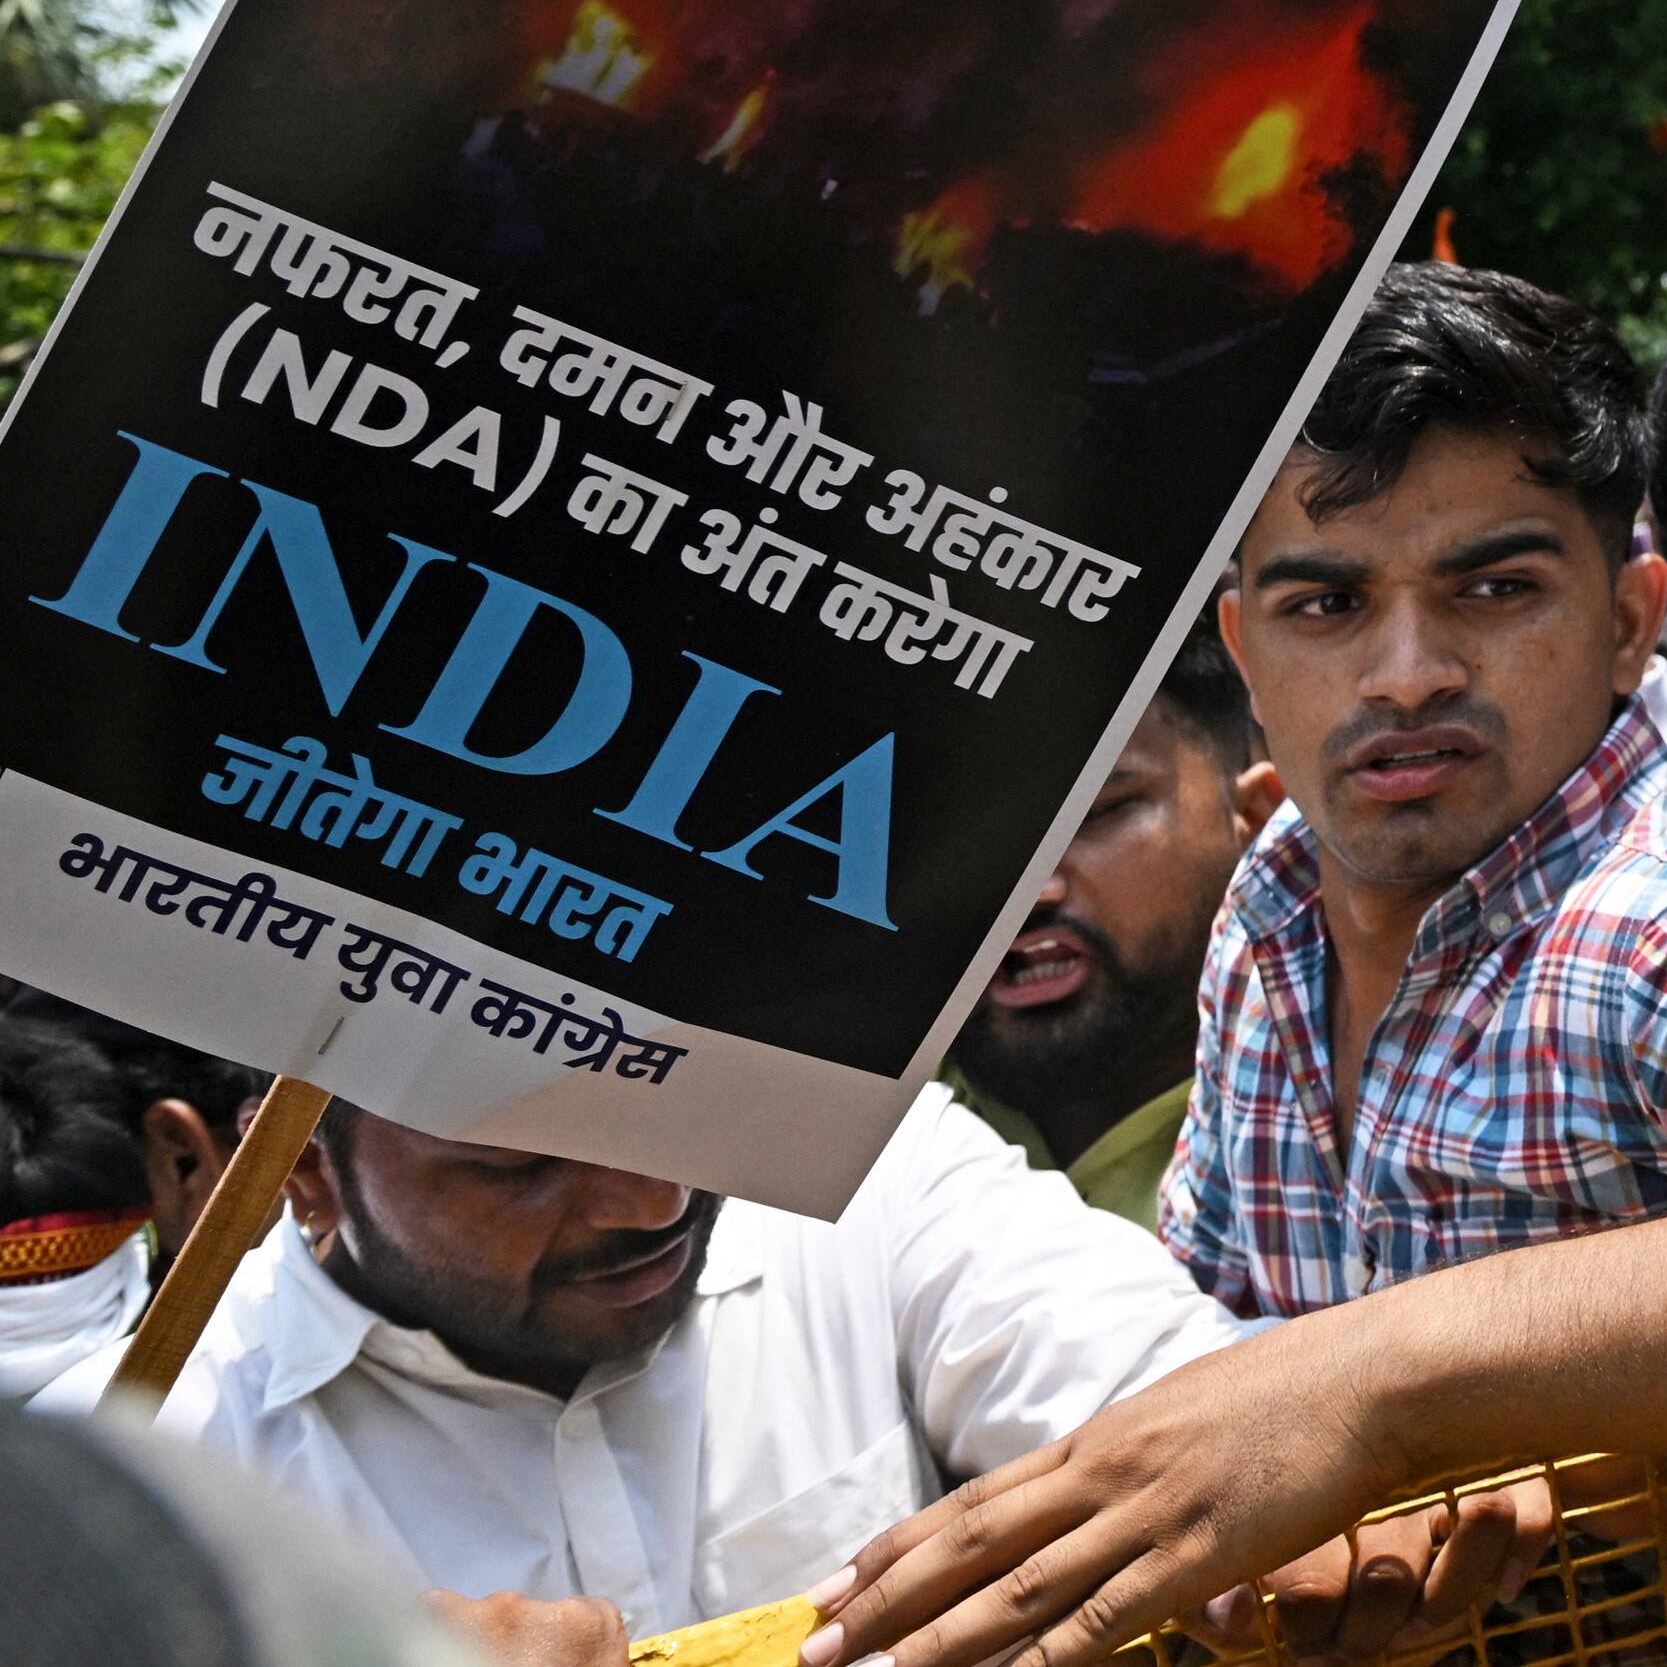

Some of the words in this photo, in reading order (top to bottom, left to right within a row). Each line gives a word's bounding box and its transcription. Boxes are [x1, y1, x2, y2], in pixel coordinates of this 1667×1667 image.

[193, 181, 480, 367] नफरत,
[498, 305, 715, 445] दमन
[704, 391, 874, 511] और
[867, 469, 1141, 624] अहंकार
[200, 303, 562, 519] (NDA)
[565, 451, 689, 557] का
[680, 504, 829, 616] अंत
[818, 560, 1034, 702] करेगा
[27, 430, 900, 932] INDIA
[200, 734, 463, 880] जीतेगा
[457, 831, 675, 964] भारत
[58, 831, 332, 961] भारतीय
[334, 922, 474, 1016] युवा
[469, 992, 690, 1086] कांग्रेस
